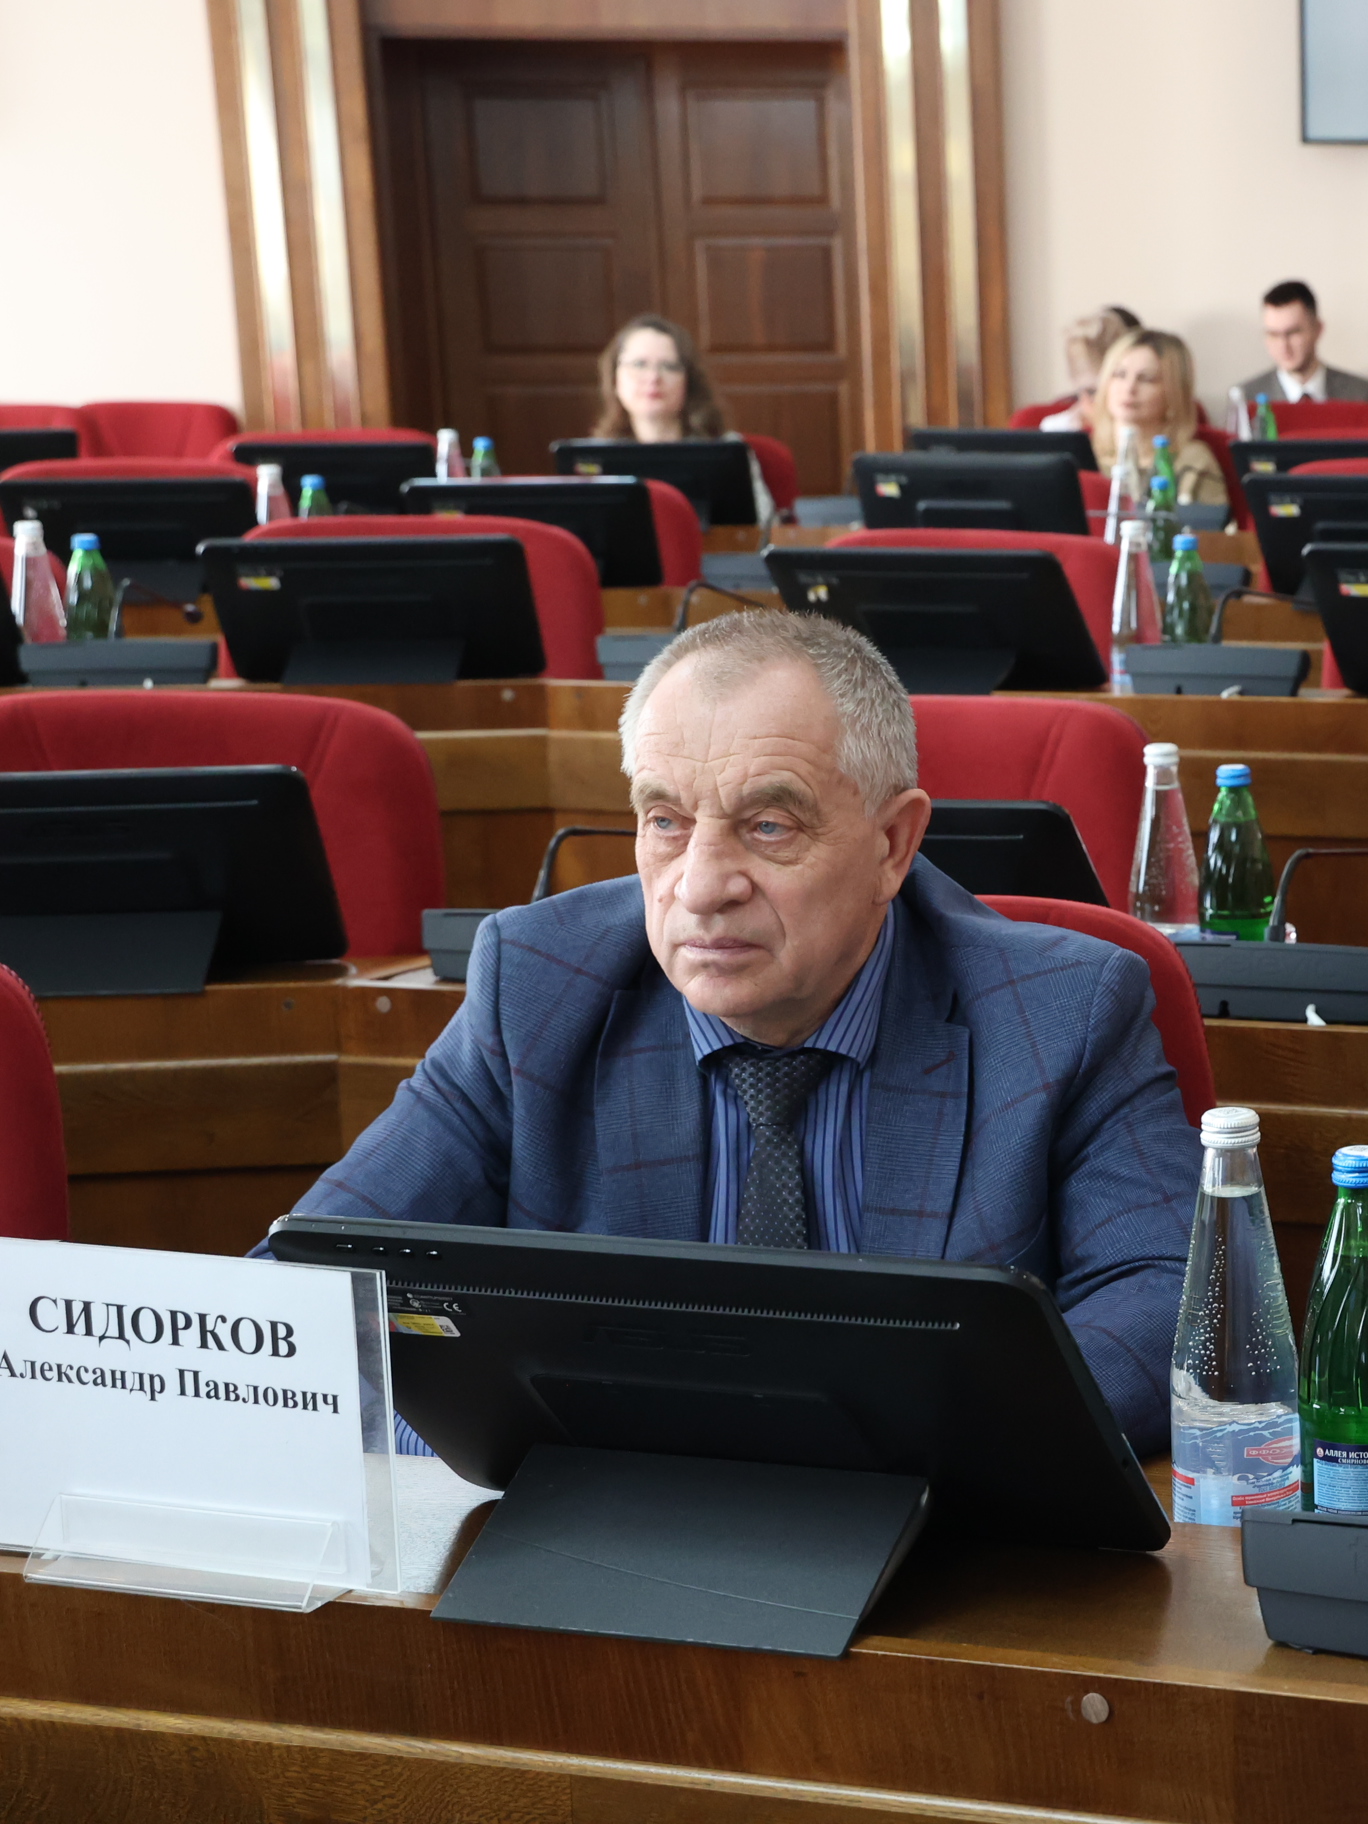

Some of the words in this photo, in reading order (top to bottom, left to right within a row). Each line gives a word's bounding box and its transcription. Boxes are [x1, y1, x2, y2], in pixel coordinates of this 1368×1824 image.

[29, 1296, 296, 1358] СИДОРКОВ
[0, 1350, 165, 1401] Александр
[176, 1368, 339, 1414] Павлович
[1325, 1448, 1347, 1458] АЛЛЕЯ
